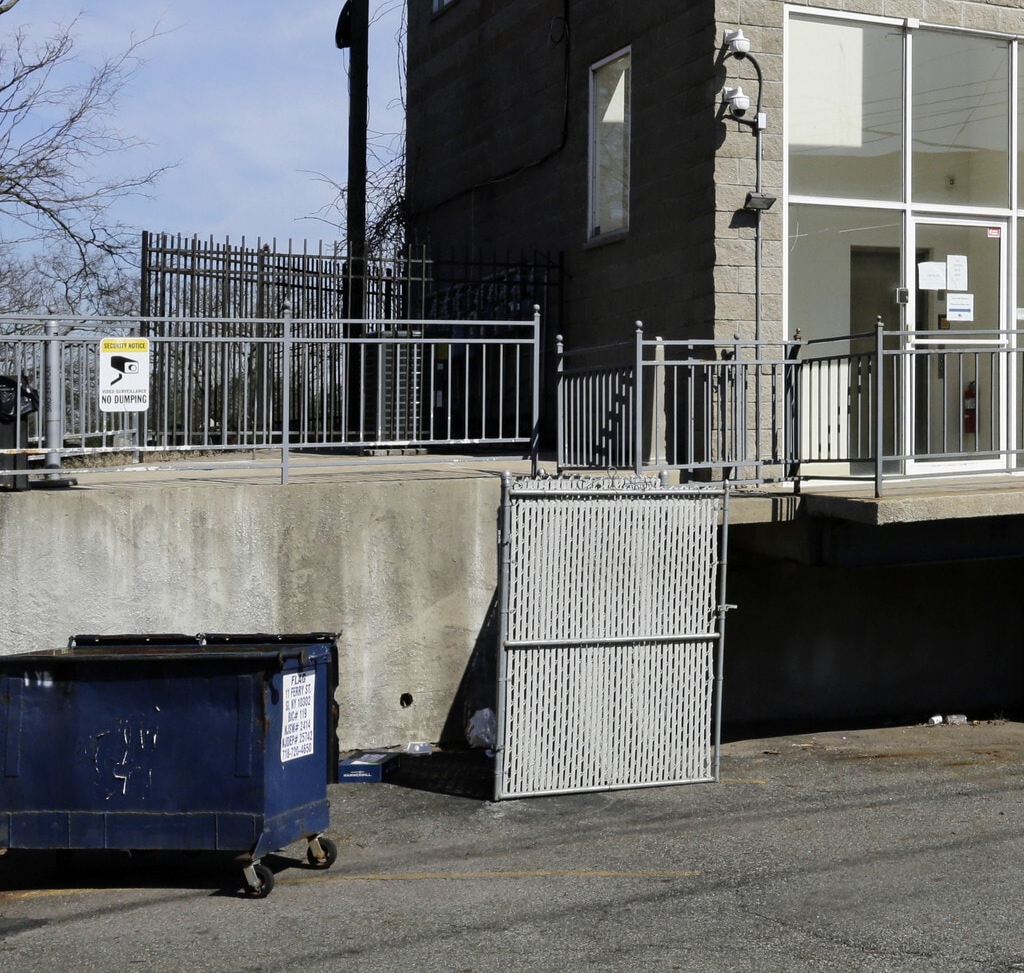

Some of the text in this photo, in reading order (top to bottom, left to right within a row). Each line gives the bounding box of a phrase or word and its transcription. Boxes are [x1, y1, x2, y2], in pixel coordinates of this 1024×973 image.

[102, 395, 147, 404] NO DUMPING
[291, 673, 306, 686] FLAG
[286, 689, 290, 699] 11
[291, 685, 304, 698] FERRY
[291, 698, 297, 709] NY
[300, 719, 311, 732] 2414
